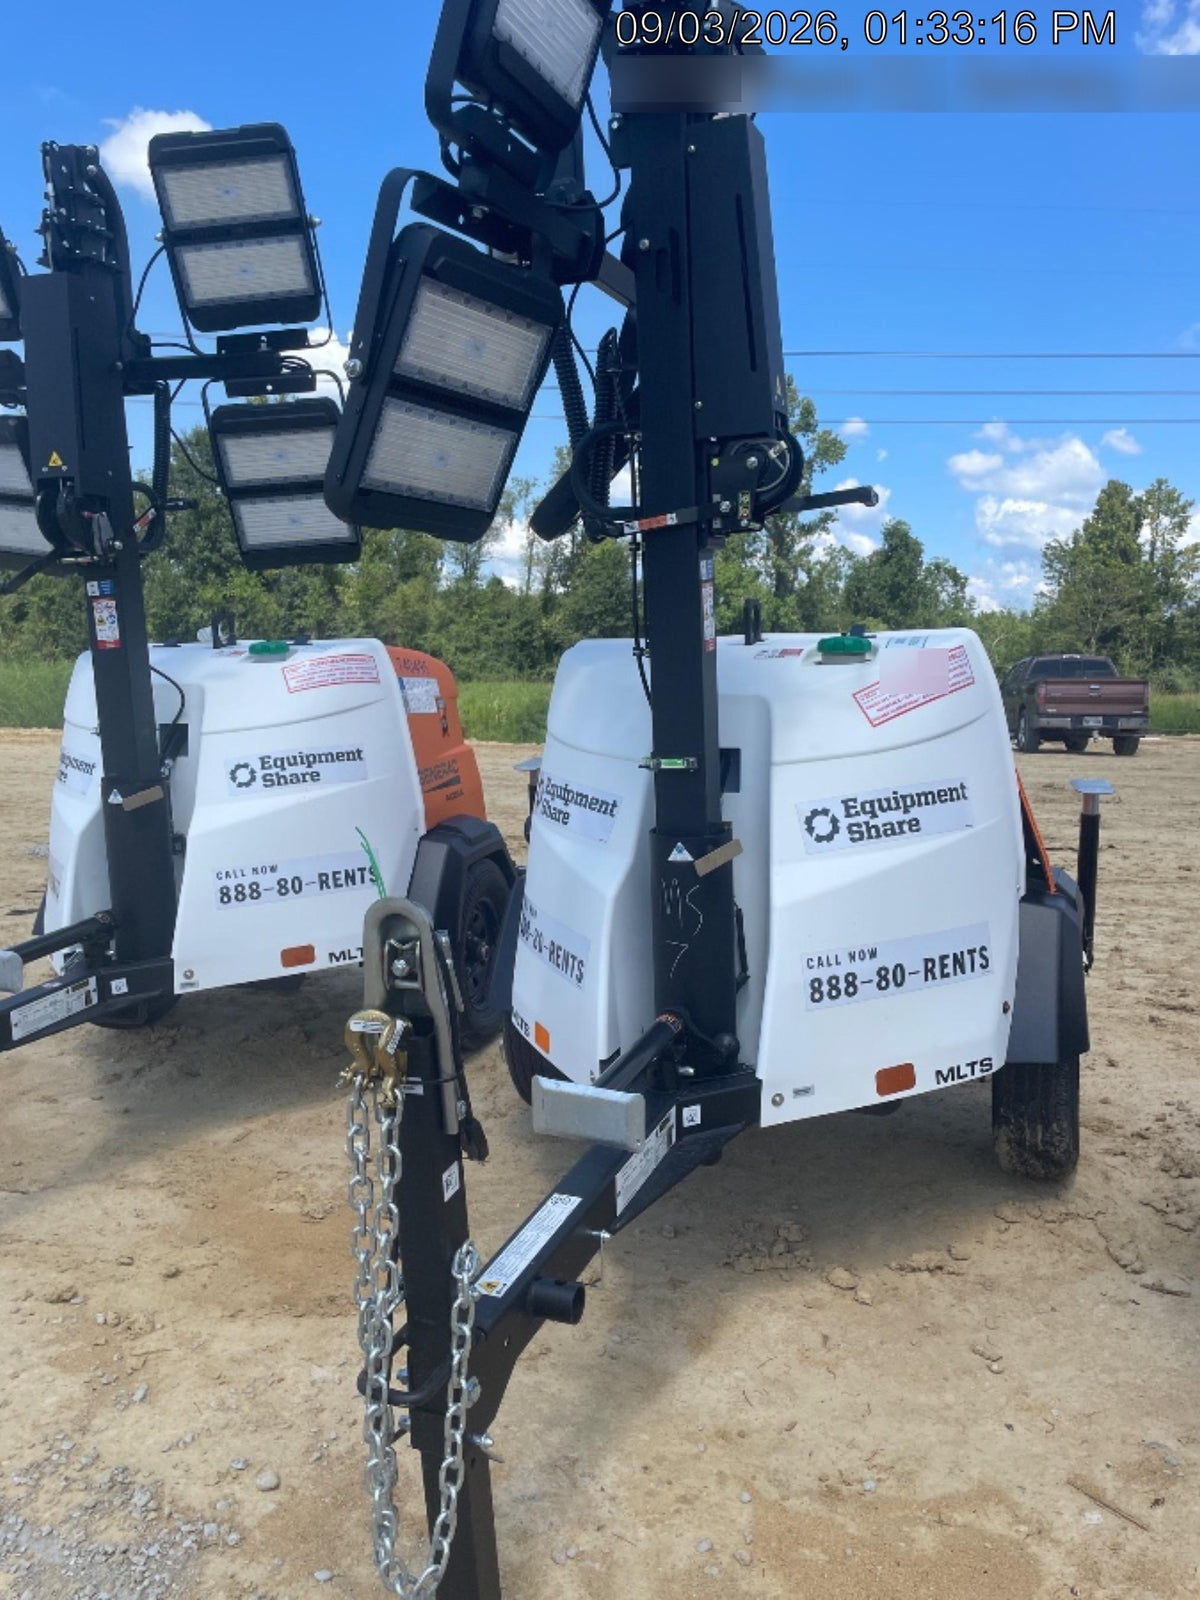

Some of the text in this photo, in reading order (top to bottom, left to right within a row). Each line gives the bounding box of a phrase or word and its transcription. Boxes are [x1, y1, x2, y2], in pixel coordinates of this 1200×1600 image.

[258, 747, 364, 772] Equipment
[261, 769, 321, 788] Share
[840, 782, 969, 820] Equipment
[846, 817, 922, 843] Share
[216, 864, 278, 880] CALL NOW
[219, 865, 379, 904] 888-80-RENTS
[328, 947, 364, 964] MLT
[806, 947, 878, 970] CALL NOW
[809, 945, 990, 1004] 888-80-RENTS
[935, 1057, 993, 1085] MLTS
